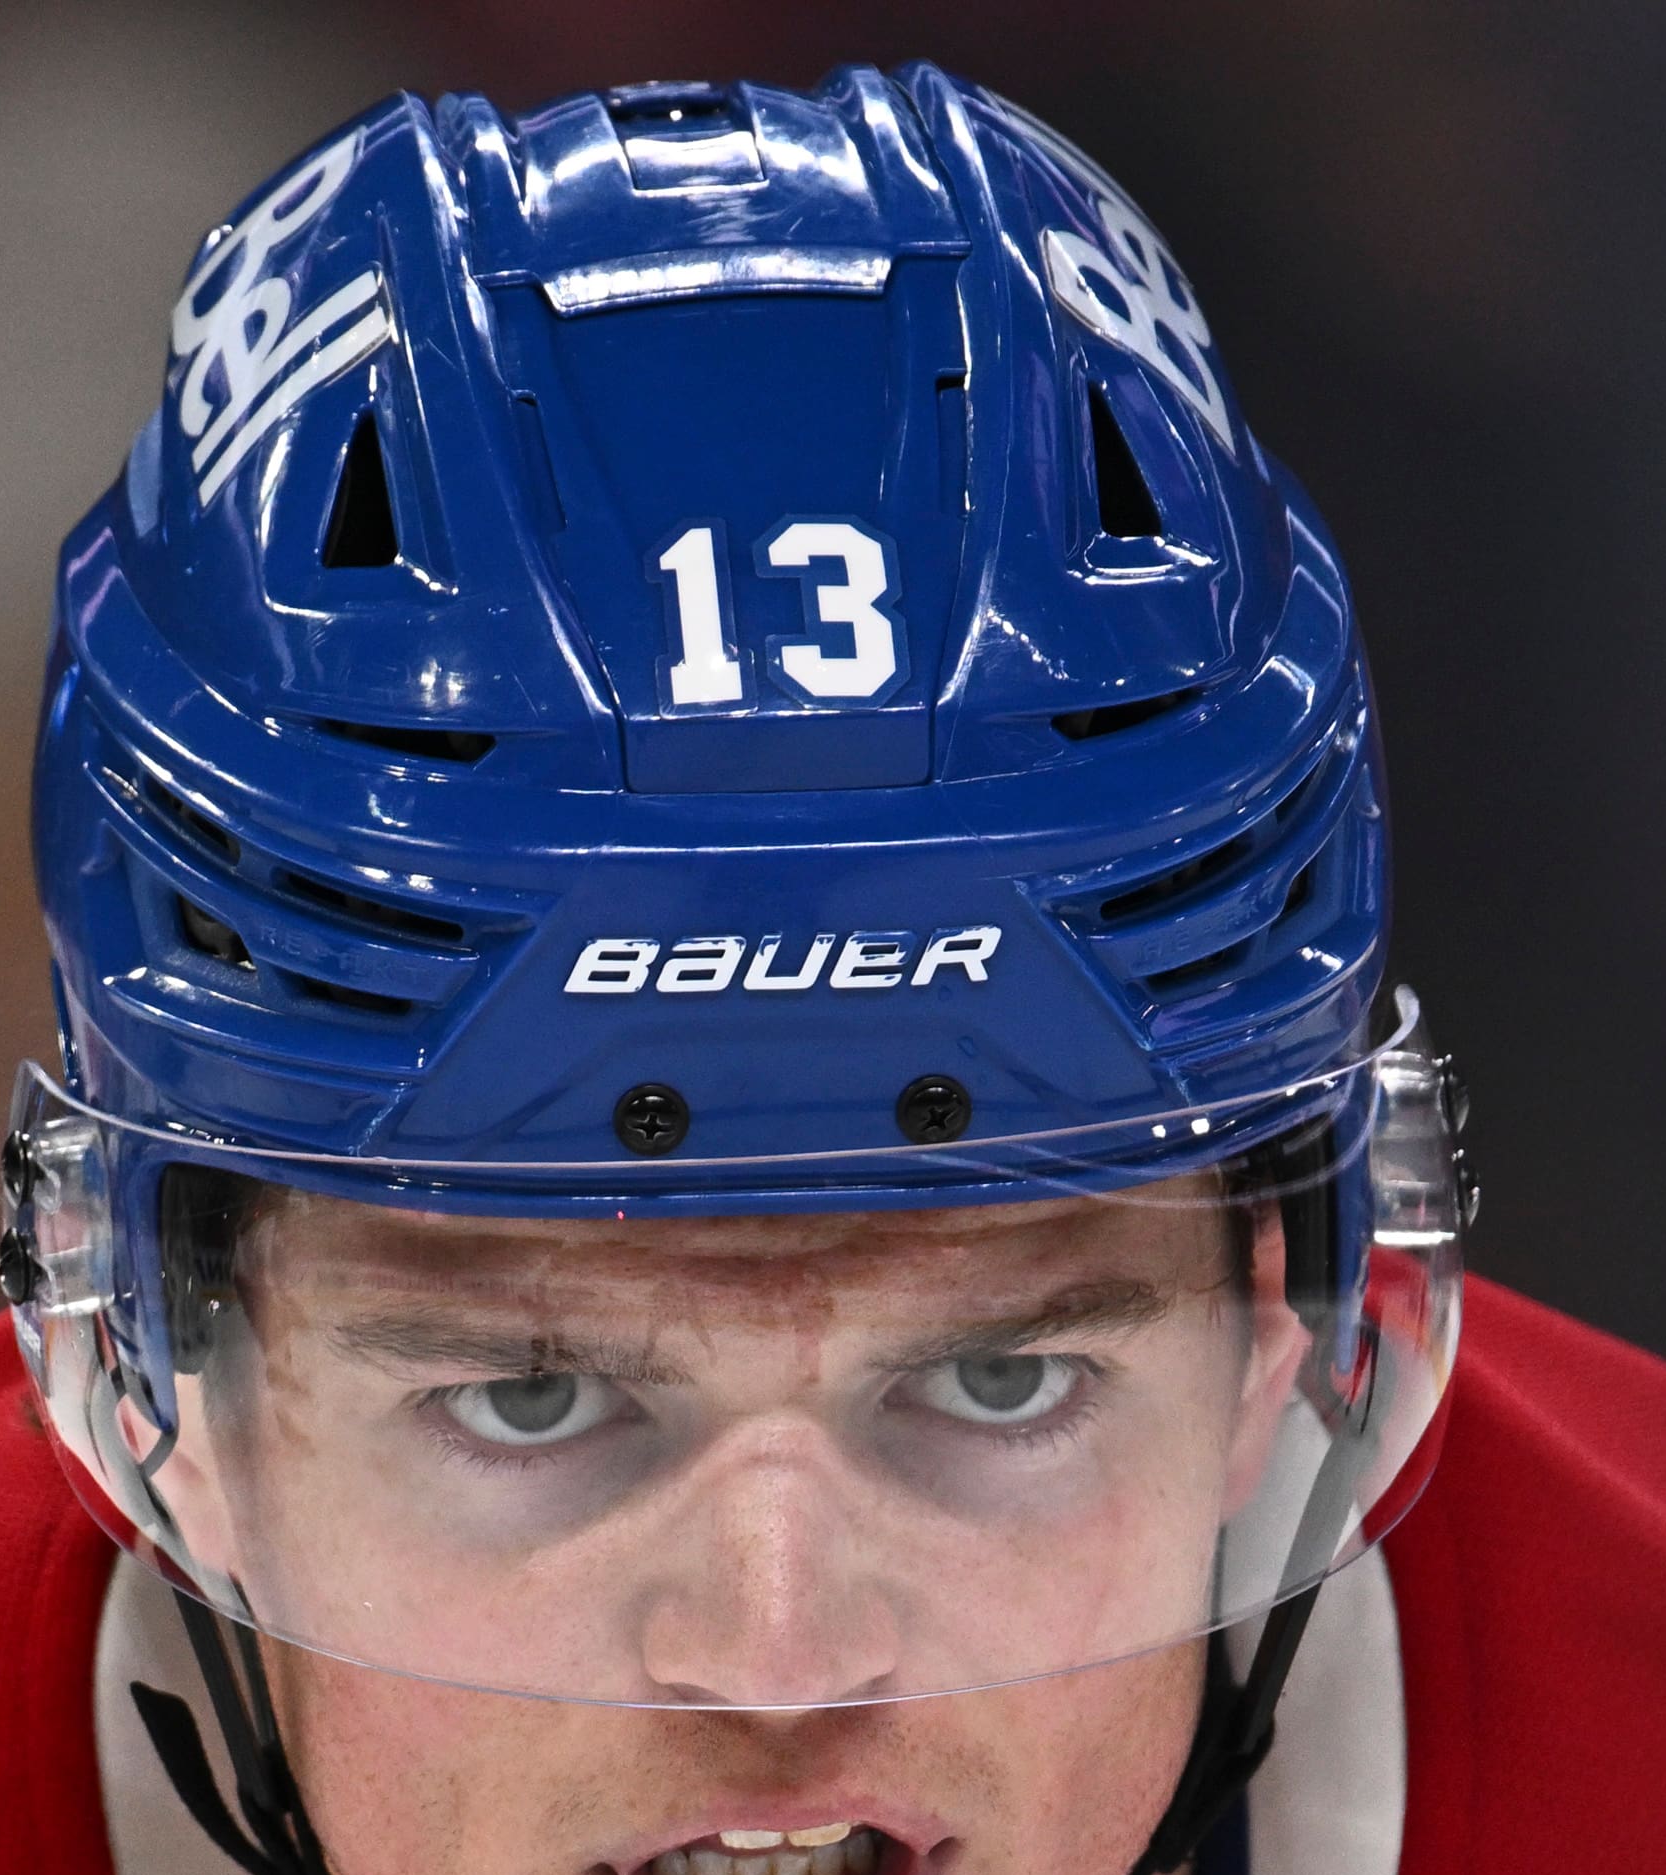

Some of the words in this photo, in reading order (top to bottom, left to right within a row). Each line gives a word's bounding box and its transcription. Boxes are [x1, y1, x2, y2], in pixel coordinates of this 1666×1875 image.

[171, 127, 395, 508] Bell
[658, 522, 896, 705] 13
[563, 925, 1002, 994] BAUER
